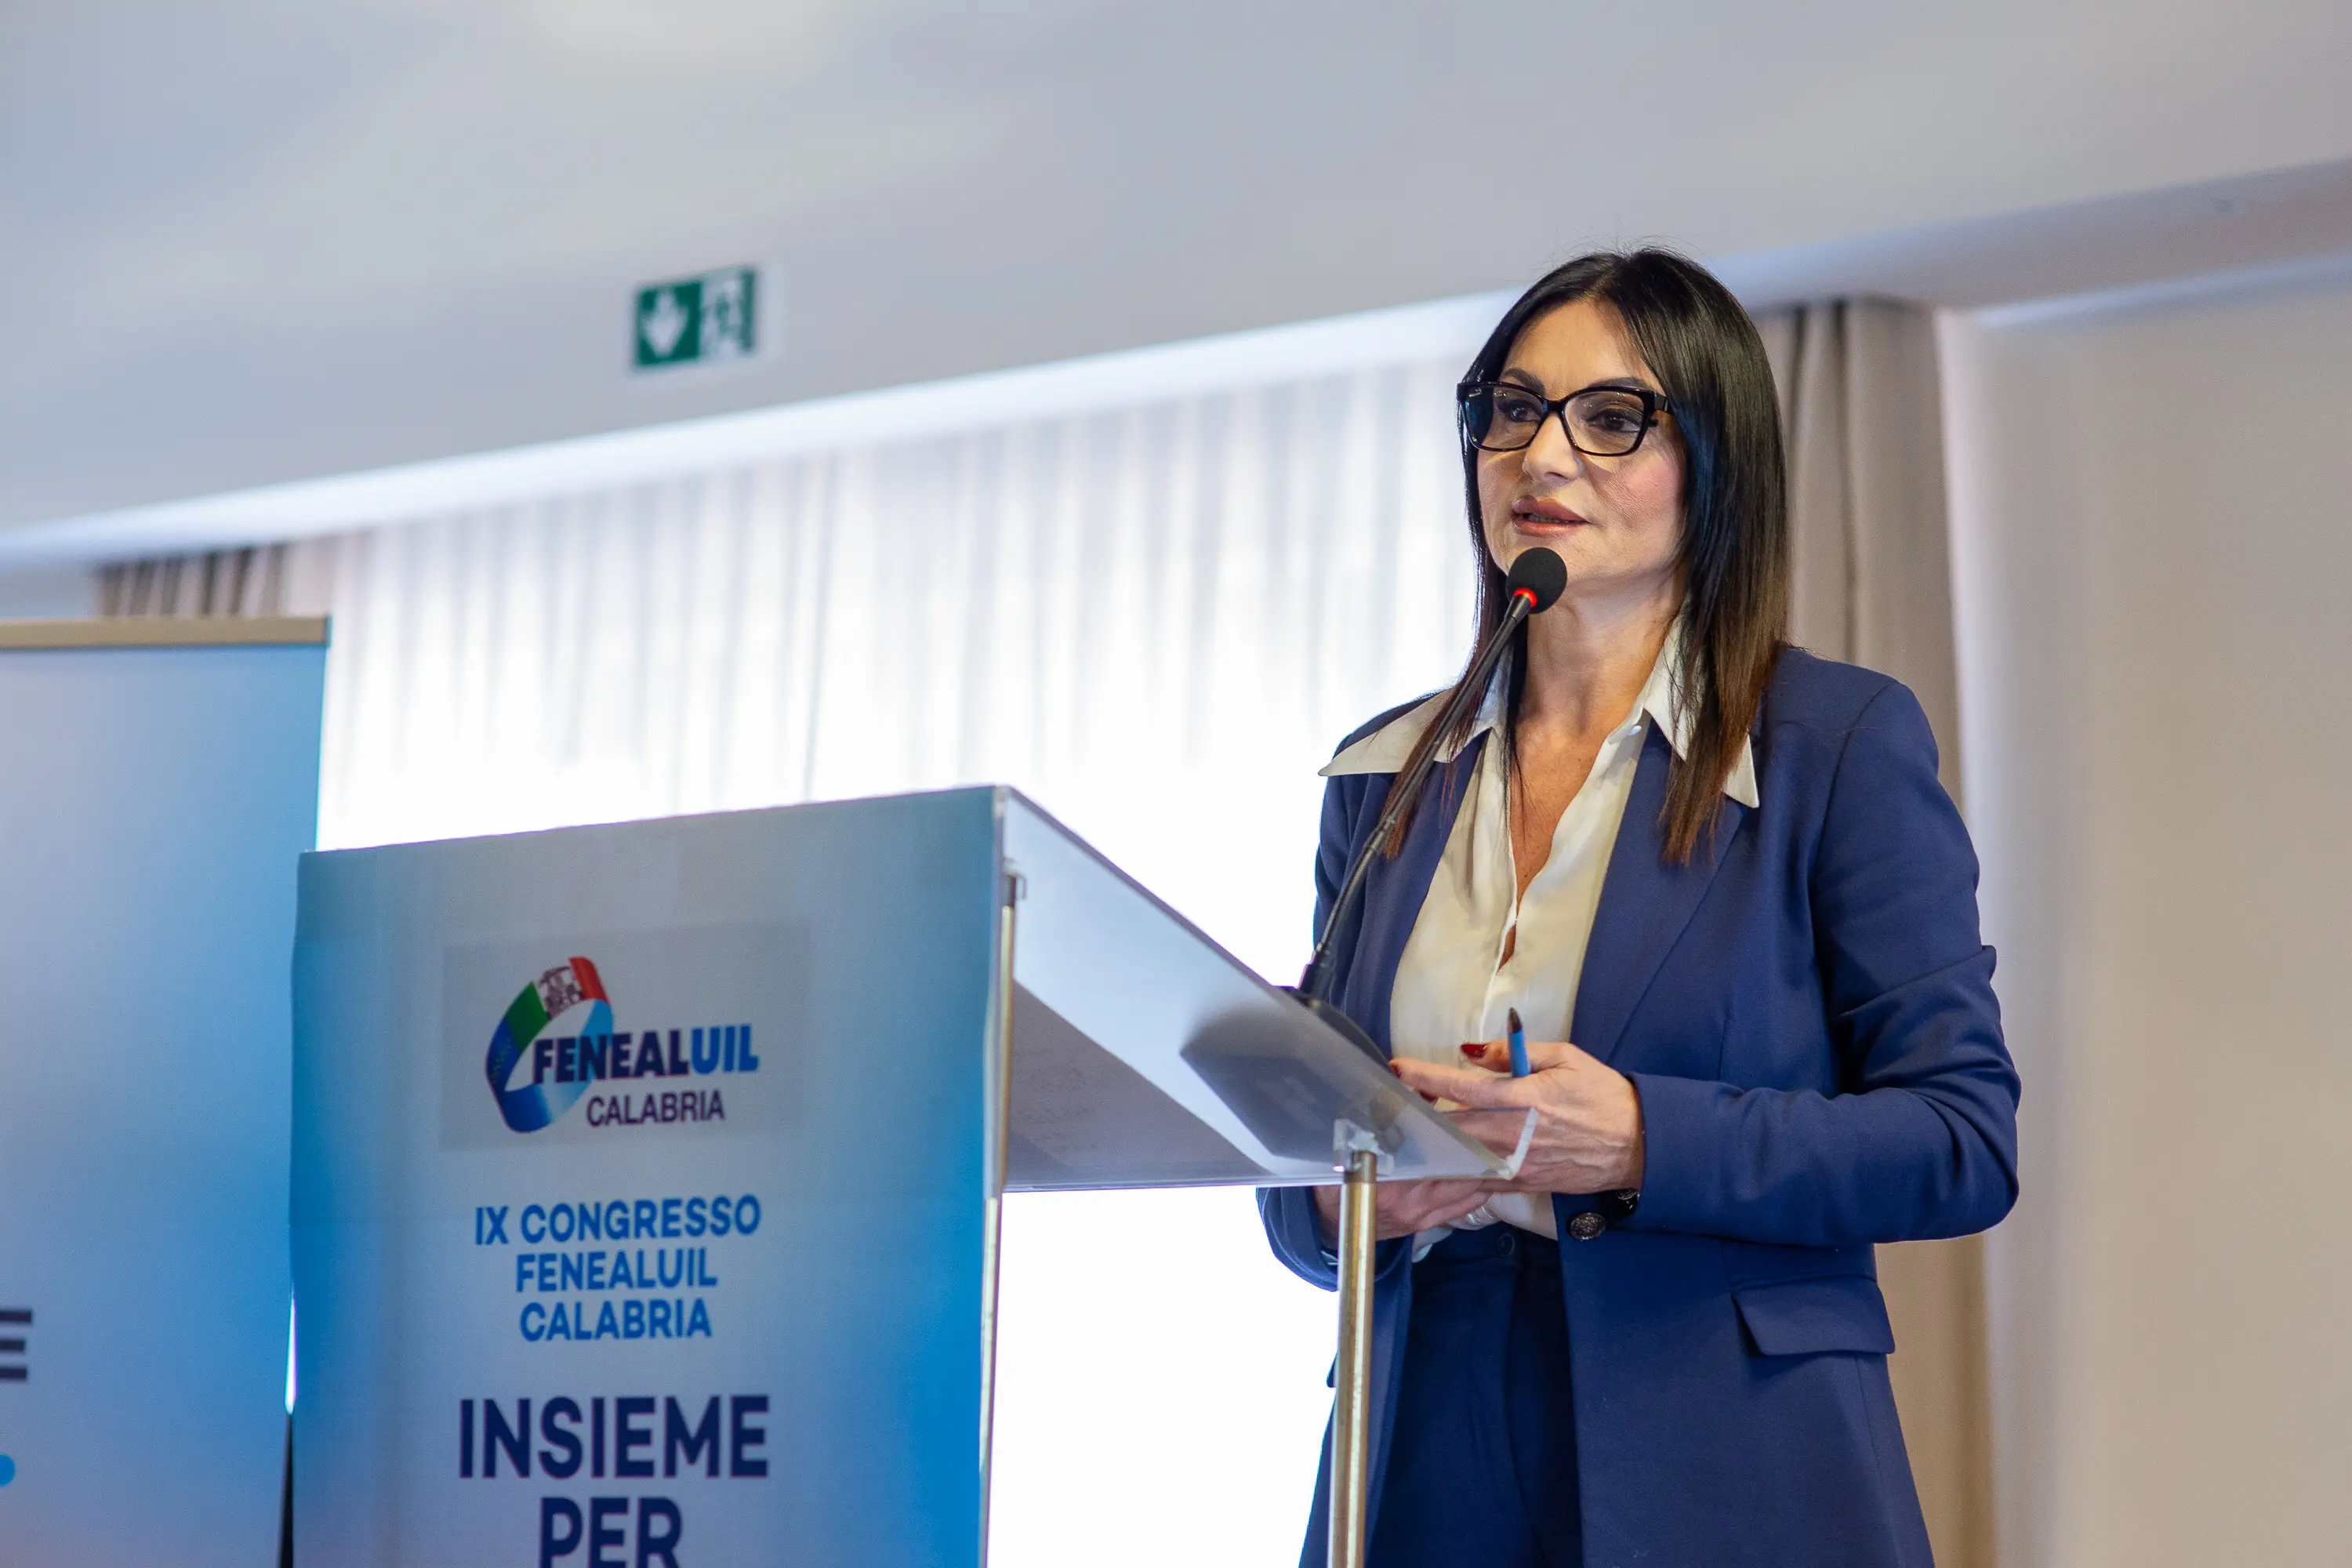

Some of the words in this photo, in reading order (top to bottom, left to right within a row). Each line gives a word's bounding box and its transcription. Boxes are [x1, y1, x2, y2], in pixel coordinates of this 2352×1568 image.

[534, 1024, 759, 1083] FENEALUIL
[586, 1090, 724, 1127] CALABRIA
[476, 1207, 509, 1245] IX
[521, 1194, 760, 1243] CONGRESSO
[516, 1247, 717, 1292] FENEALUIL
[520, 1298, 712, 1341] CALABRIA
[460, 1396, 769, 1479] INSIEME
[540, 1497, 683, 1568] PER
